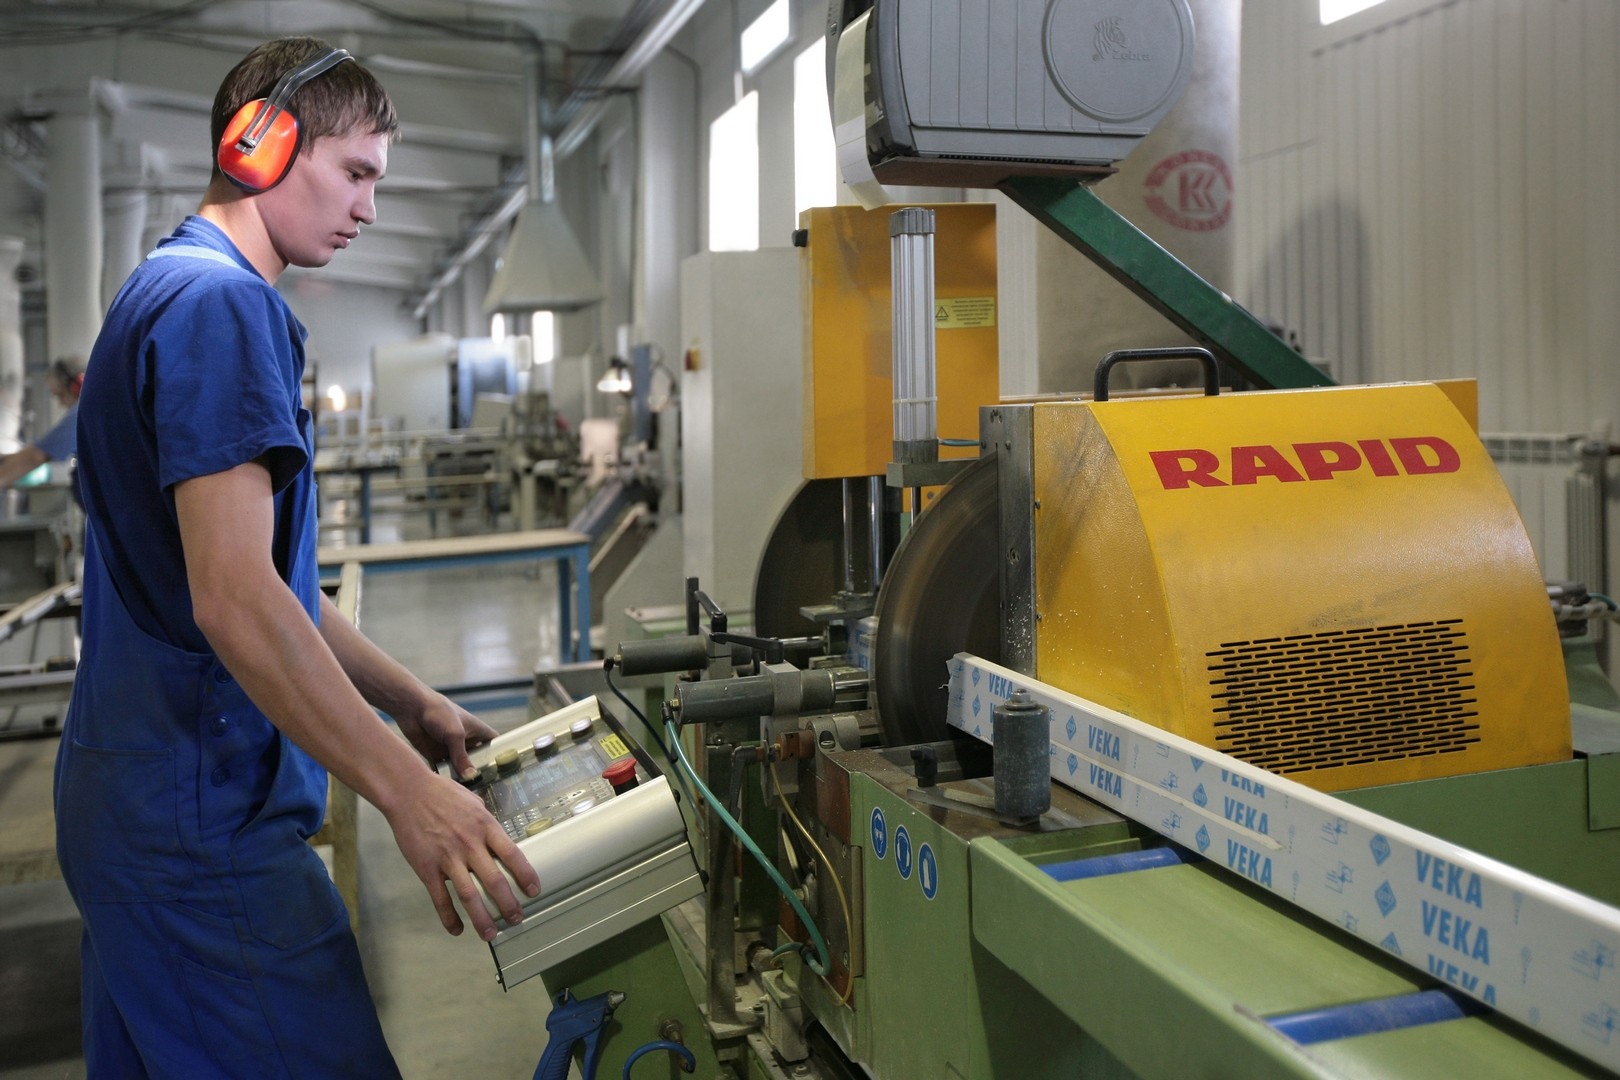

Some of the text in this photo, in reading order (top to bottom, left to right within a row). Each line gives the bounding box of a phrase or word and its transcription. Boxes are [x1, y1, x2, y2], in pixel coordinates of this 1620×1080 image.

[1149, 436, 1461, 490] RAPID
[989, 672, 1013, 700] VEKA
[1088, 724, 1120, 761] VEKA
[1090, 762, 1122, 798] VEKA
[1224, 796, 1268, 835] VEKA
[1227, 838, 1273, 888] VEKA
[1416, 849, 1482, 909] VEKA
[1422, 900, 1489, 966] VEKA
